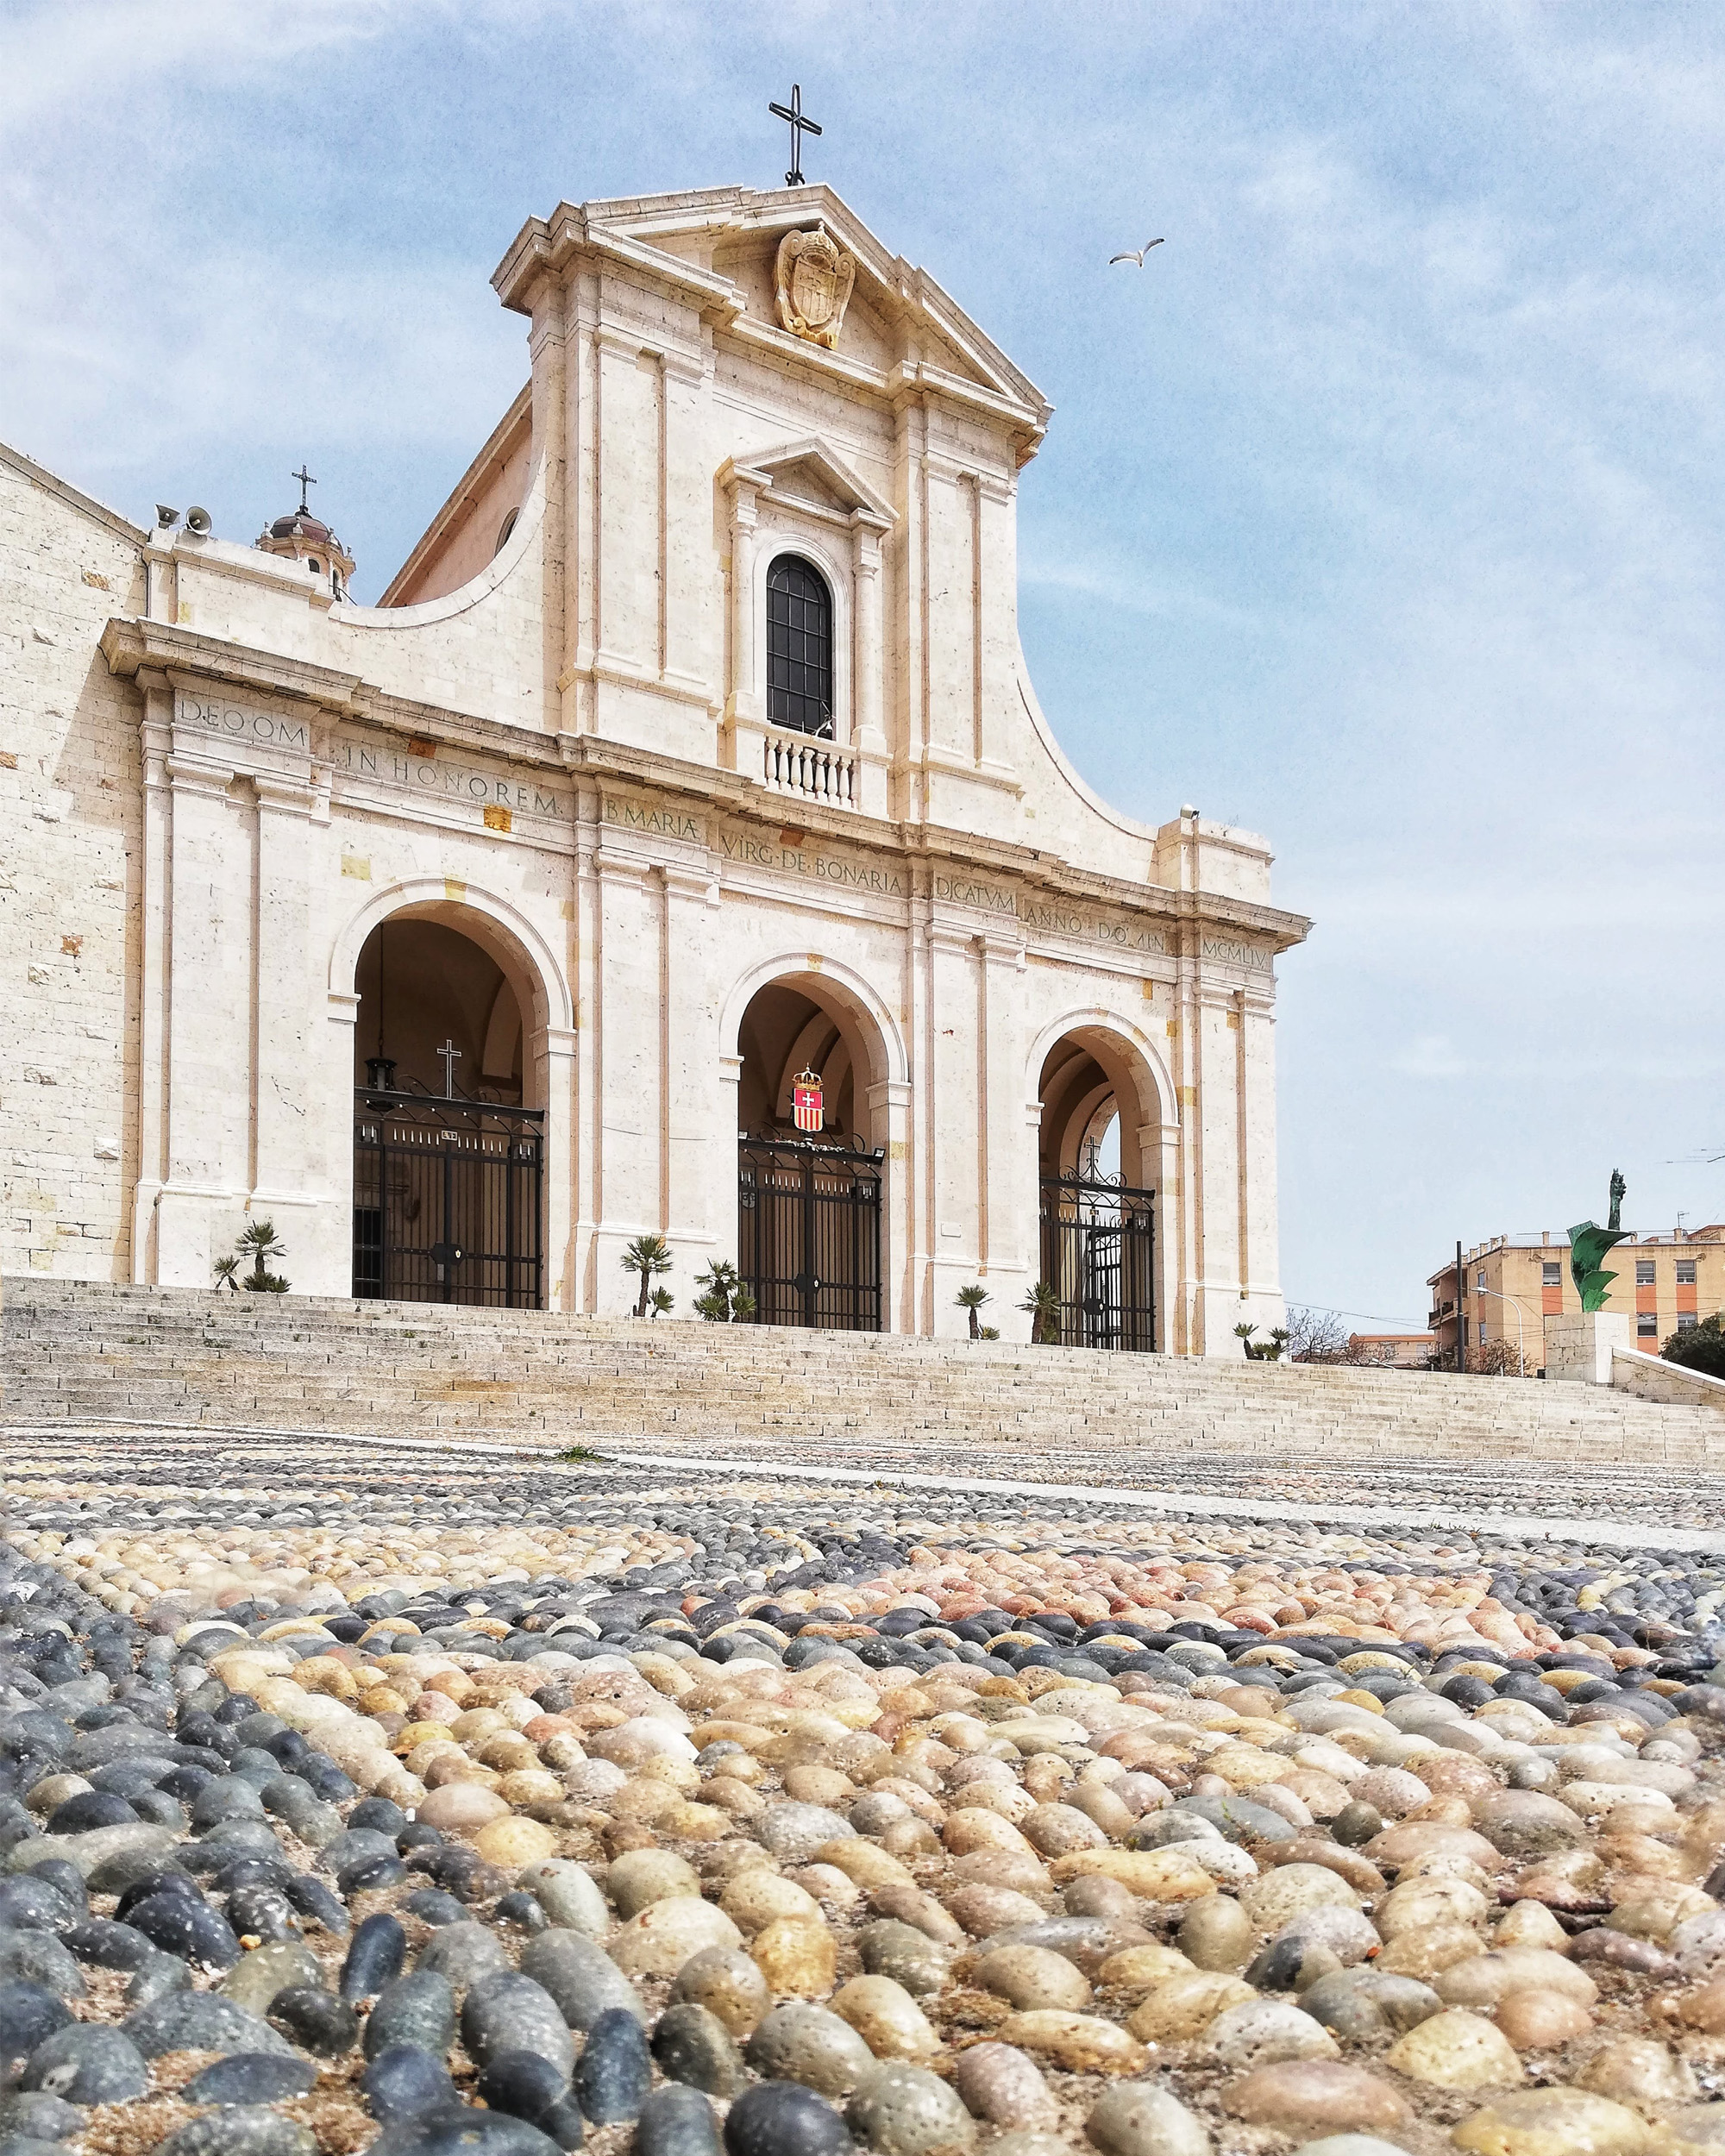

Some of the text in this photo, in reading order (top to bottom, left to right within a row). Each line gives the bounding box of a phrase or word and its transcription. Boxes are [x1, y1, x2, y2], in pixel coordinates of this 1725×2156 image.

[180, 699, 245, 731] DEO
[347, 746, 559, 815] IN HONOREM
[815, 857, 902, 893] BONARIA
[936, 876, 1014, 912] DICATVM
[1025, 906, 1082, 933] ANNO
[1202, 938, 1267, 967] MCMLIV
